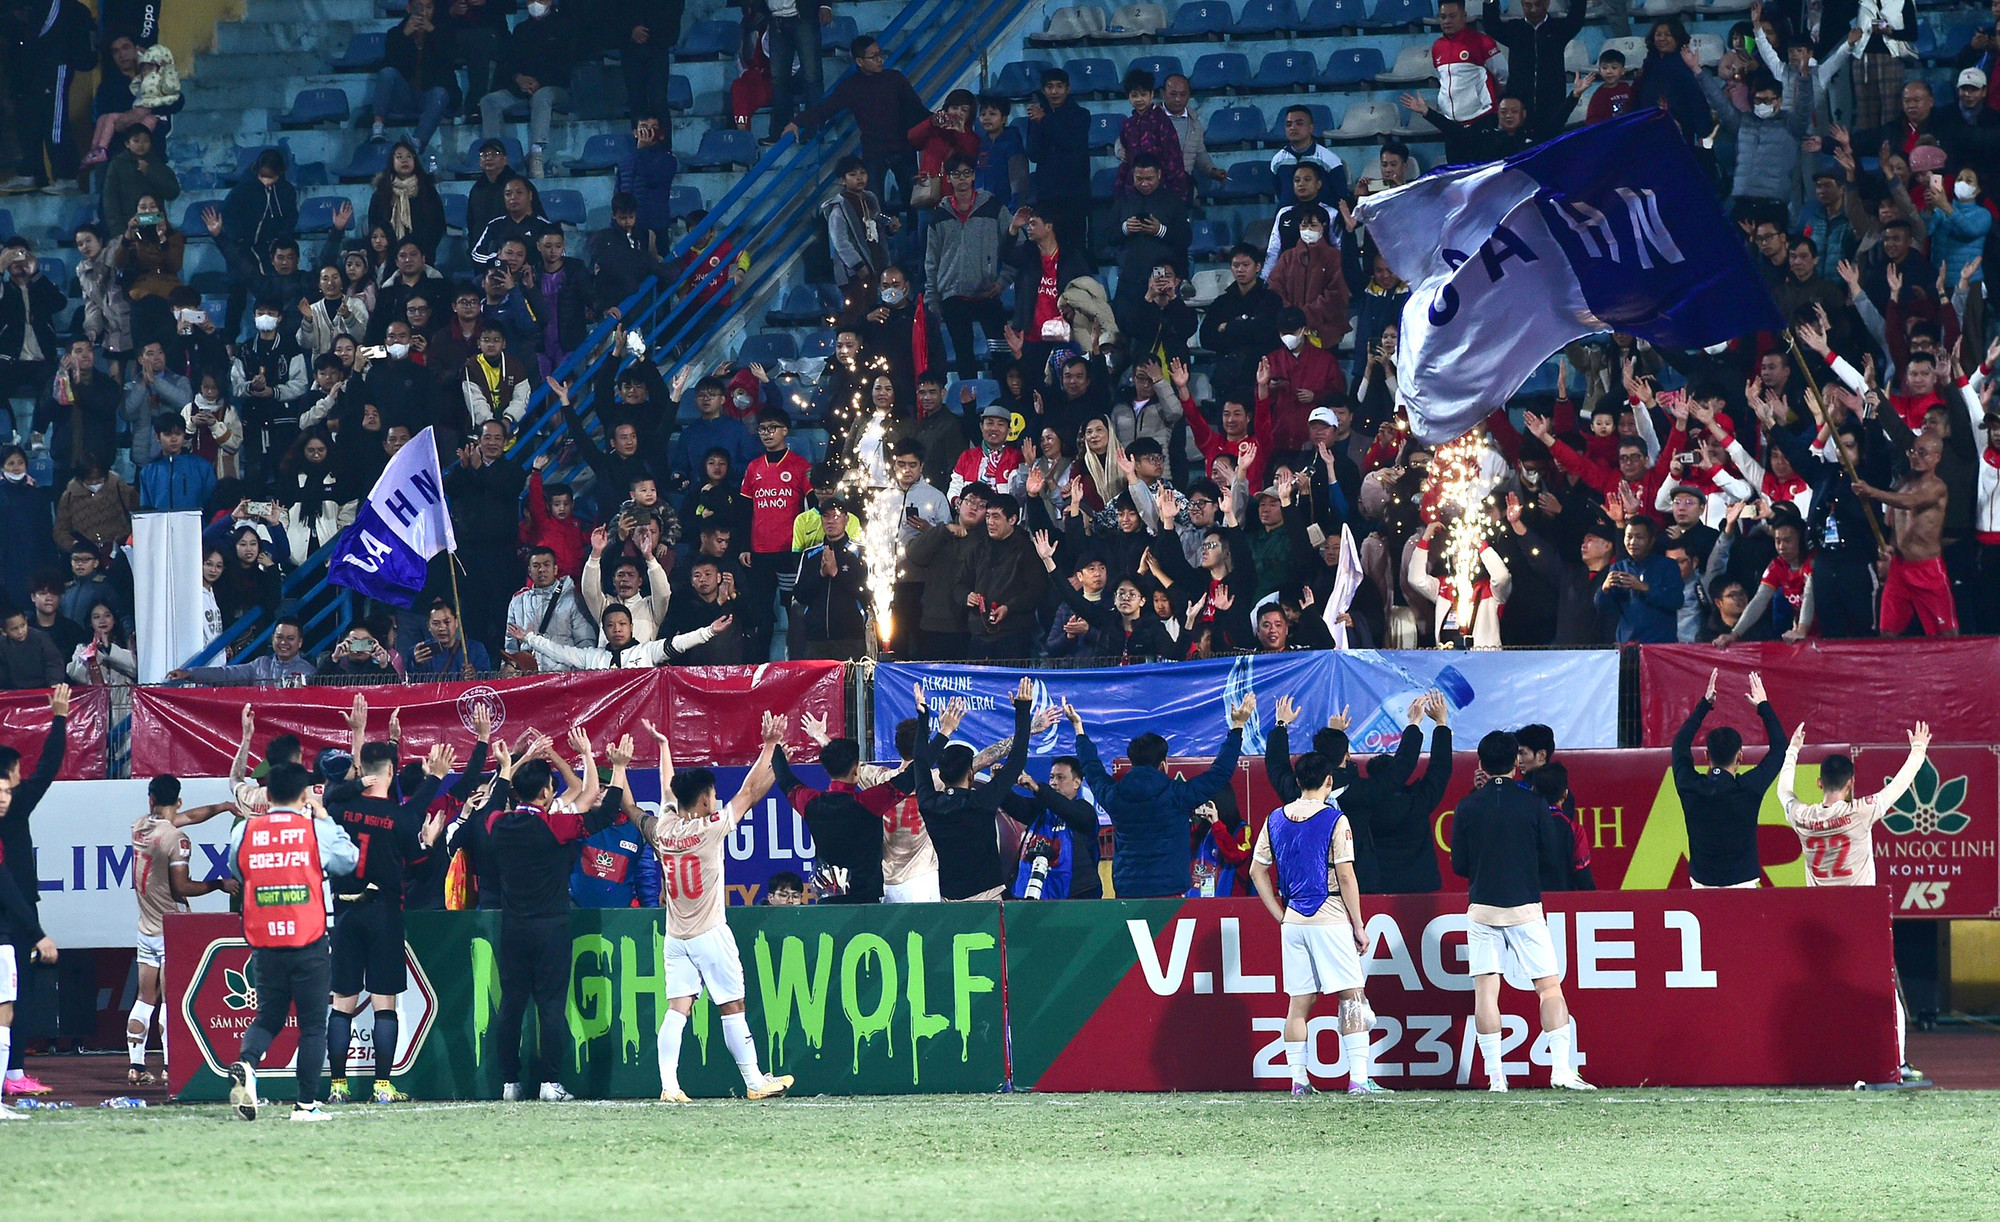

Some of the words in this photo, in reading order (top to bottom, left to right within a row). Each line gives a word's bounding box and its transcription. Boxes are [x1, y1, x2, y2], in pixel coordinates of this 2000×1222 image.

[754, 488, 777, 498] CÔNG
[778, 488, 792, 497] AN
[757, 498, 769, 508] HÀ
[769, 498, 787, 509] NỘI
[922, 676, 973, 691] ALKALINE
[343, 810, 363, 823] FILIP
[252, 831, 270, 847] HB
[280, 829, 306, 845] FPT
[355, 832, 371, 879] 1
[1806, 833, 1853, 878] 22
[1895, 841, 1947, 860] NGỌC
[1951, 841, 1995, 857] LINH
[249, 851, 310, 869] 2023/24
[1889, 864, 1962, 876] KONTUM
[282, 890, 307, 904] WOLF
[1900, 881, 1951, 910] K5
[268, 921, 296, 936] 056
[1127, 911, 1636, 997] V.LAGE
[1665, 910, 1718, 988] 1
[754, 930, 996, 1085] WOLF
[210, 1015, 232, 1029] SÂM
